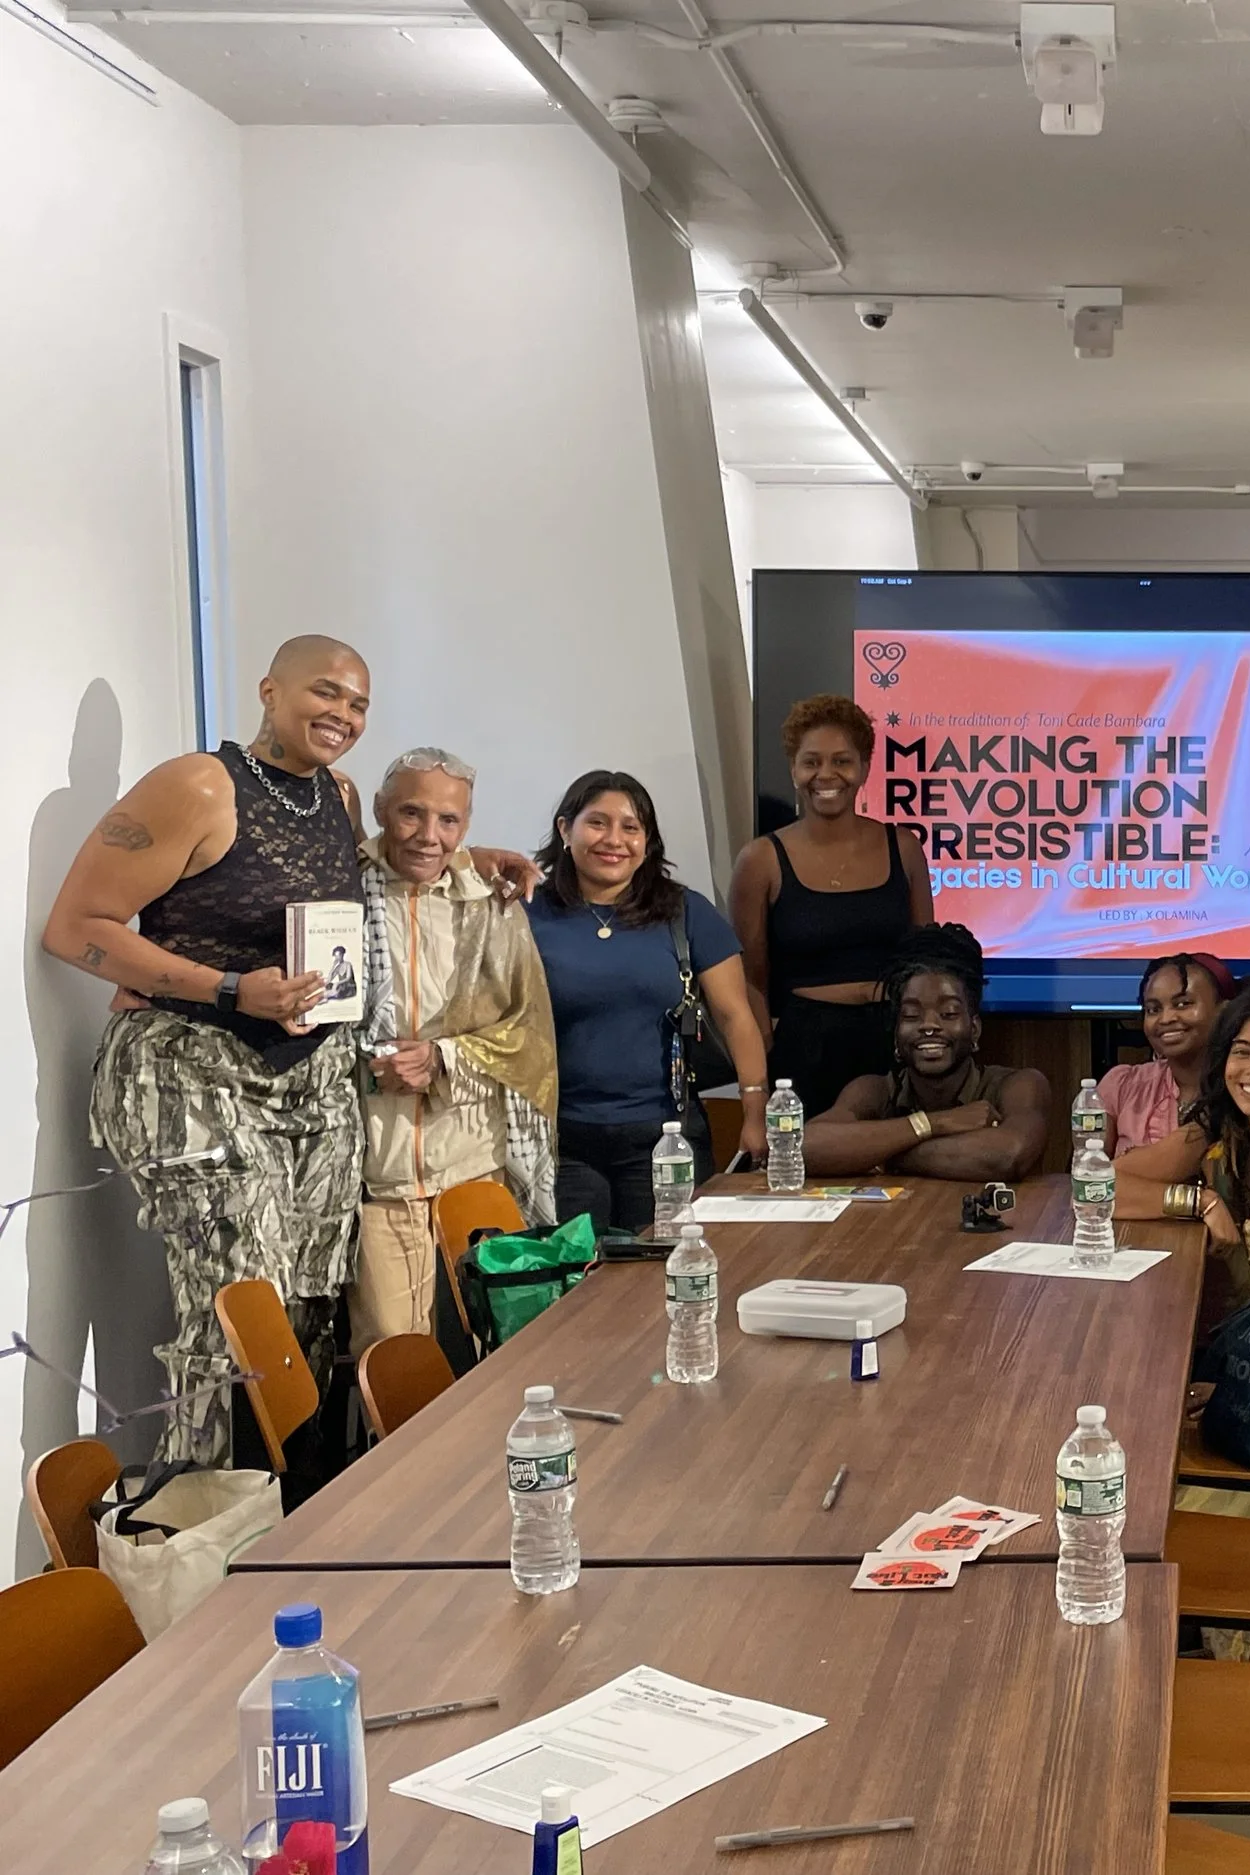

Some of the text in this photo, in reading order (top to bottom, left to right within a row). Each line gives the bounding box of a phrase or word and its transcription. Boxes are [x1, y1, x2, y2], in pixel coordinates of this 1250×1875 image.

[909, 712, 921, 727] In
[925, 712, 945, 727] the
[1038, 712, 1064, 727] Toni
[1066, 712, 1101, 728] Cade
[1104, 712, 1167, 728] Bambara
[885, 735, 1207, 774] MAKING THE
[885, 778, 1208, 818] REVOLUTION
[885, 822, 1220, 862] RESISTIBLE:
[929, 861, 1022, 897] gacies
[1031, 861, 1059, 889] in
[1068, 863, 1191, 890] Cultural
[1099, 909, 1121, 921] LED
[1146, 909, 1154, 921] X
[1155, 909, 1209, 921] OLAMINA
[509, 1460, 536, 1474] Poland
[510, 1471, 538, 1486] Spring
[257, 1744, 322, 1791] FIJI
